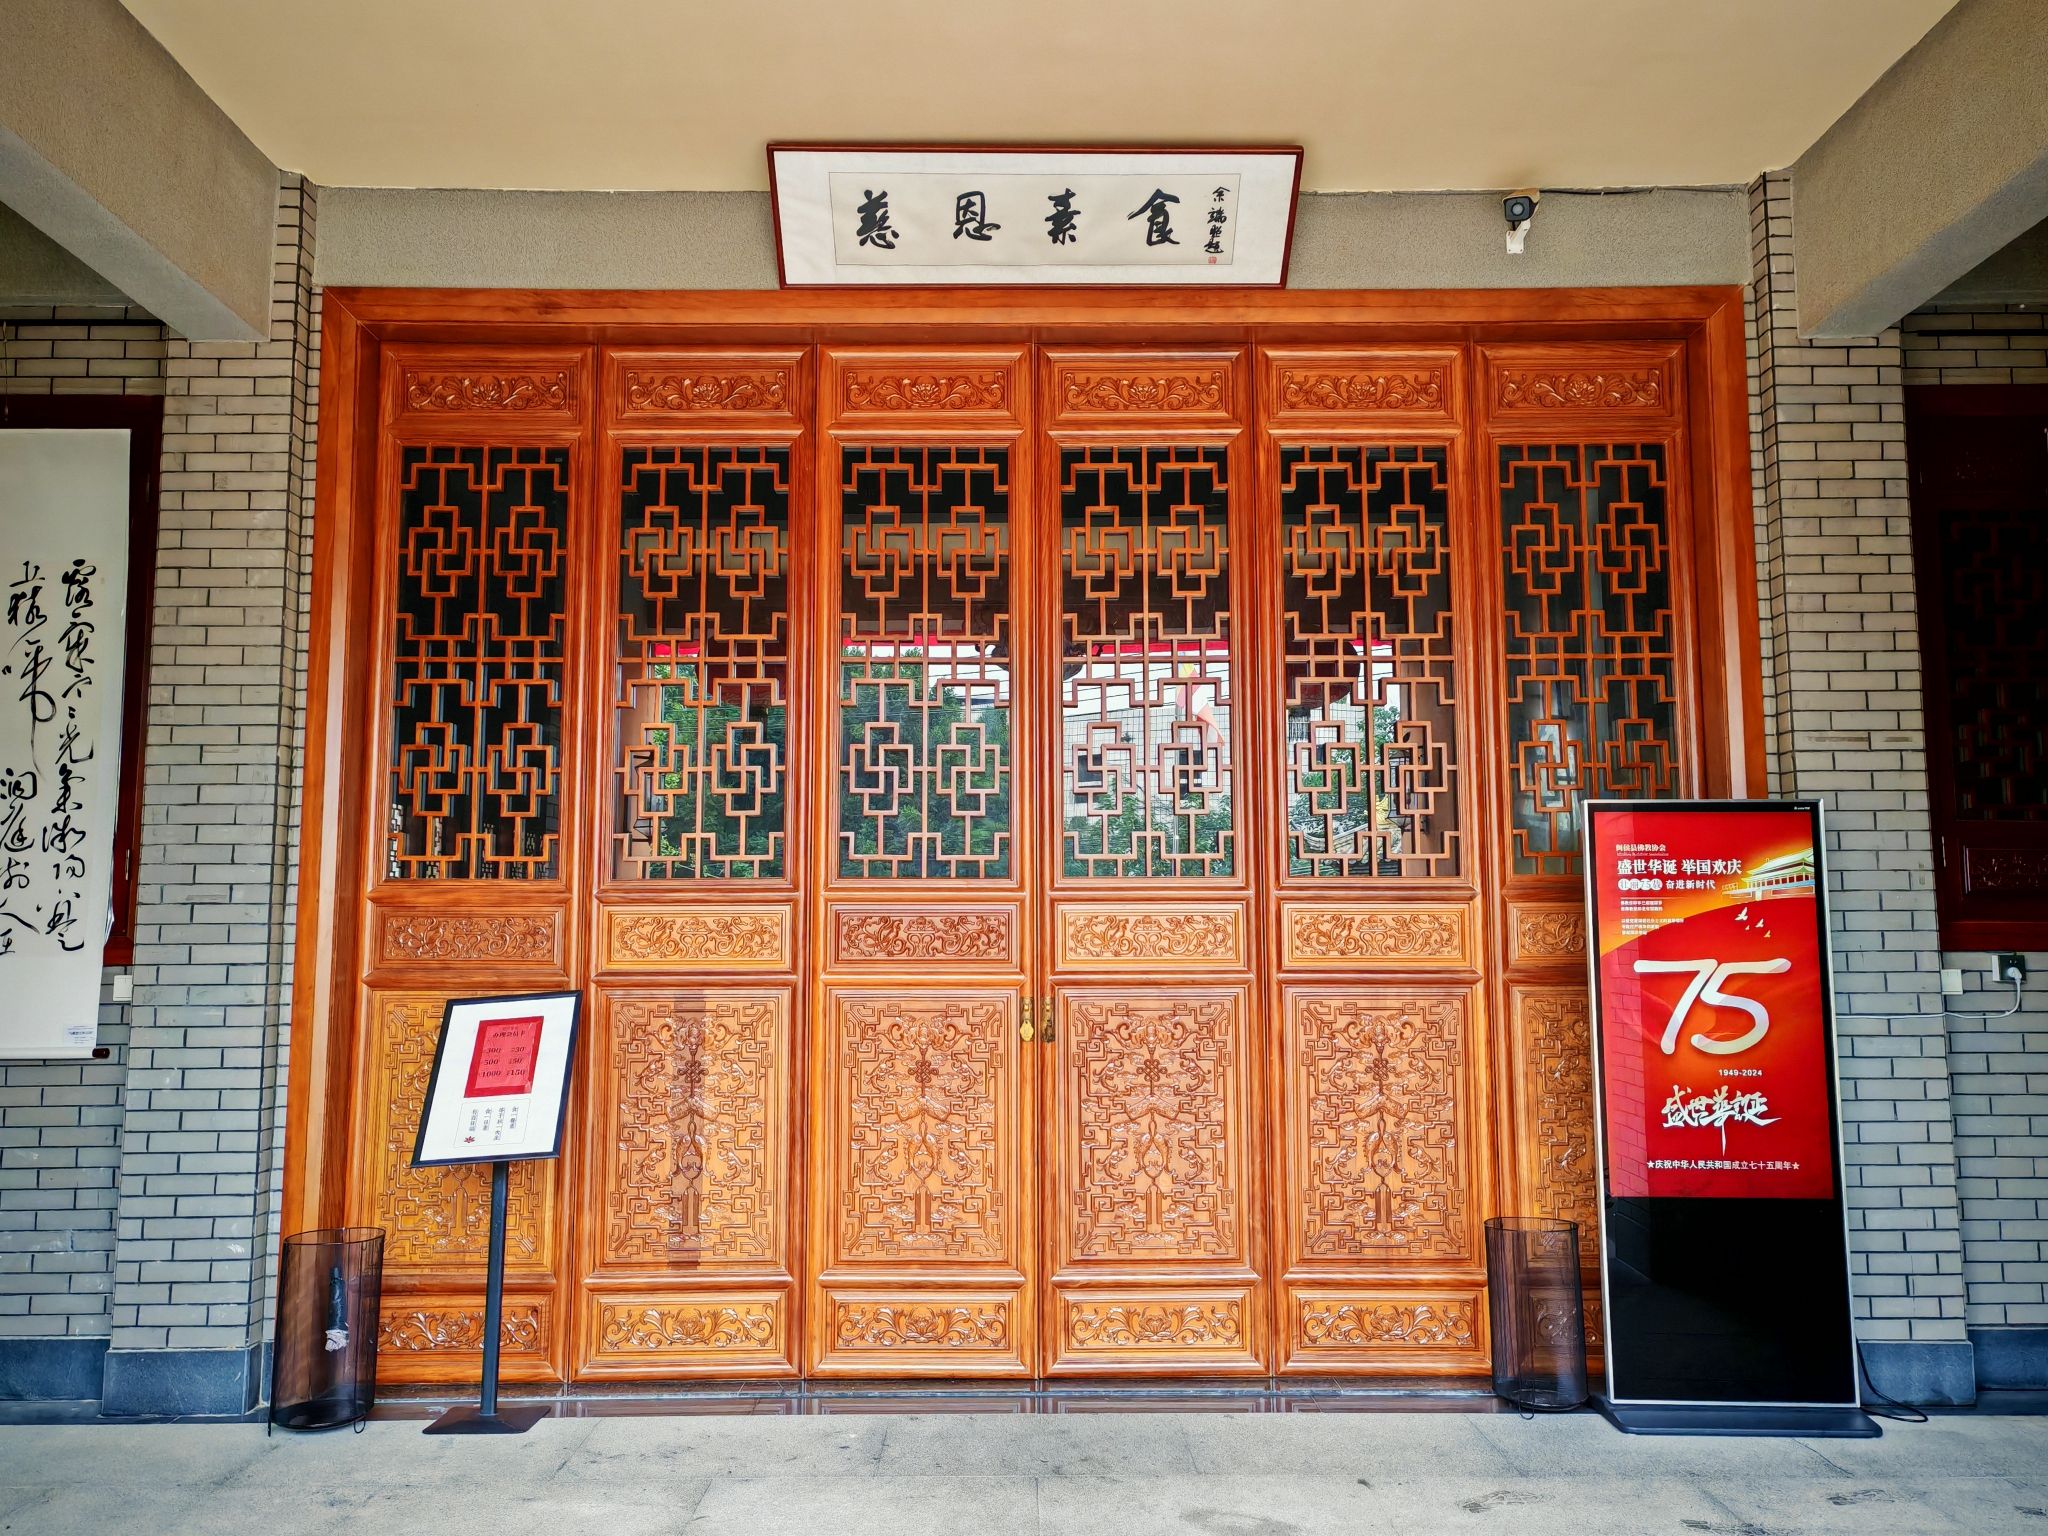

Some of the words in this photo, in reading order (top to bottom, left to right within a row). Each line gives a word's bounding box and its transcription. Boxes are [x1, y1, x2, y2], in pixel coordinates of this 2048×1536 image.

[856, 187, 1182, 250] 慈恩素食
[1617, 859, 1677, 875] 盛世华诞
[1682, 859, 1743, 875] 举国欢庆
[1665, 880, 1717, 890] 奋进新时代
[1633, 958, 1792, 1055] 75
[1718, 1069, 1763, 1077] 1949-2024
[1654, 1159, 1793, 1171] 庆祝中华人民共和国成立七十五周年
